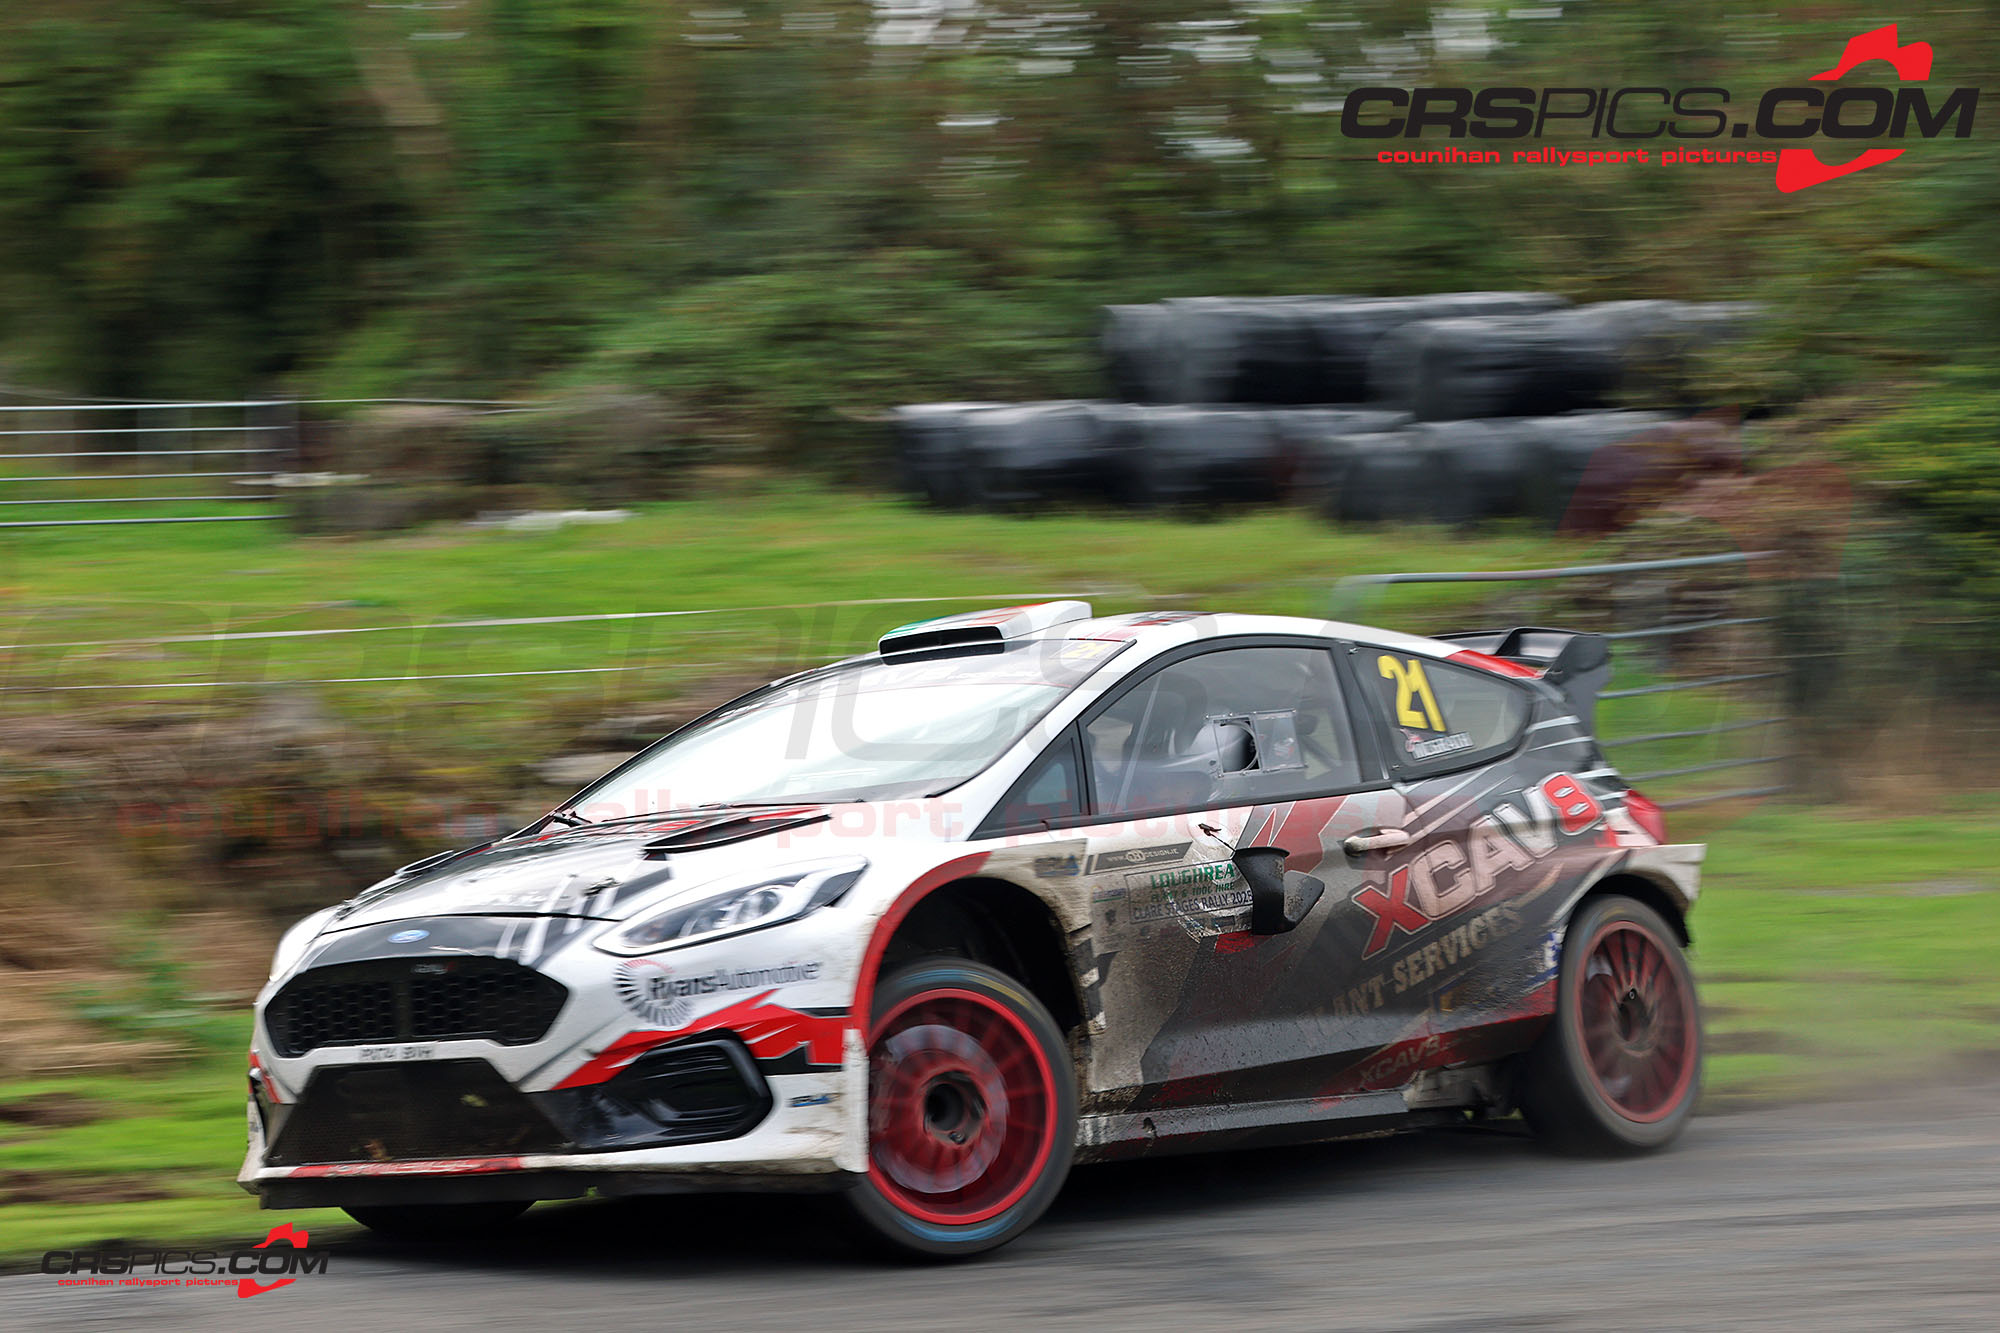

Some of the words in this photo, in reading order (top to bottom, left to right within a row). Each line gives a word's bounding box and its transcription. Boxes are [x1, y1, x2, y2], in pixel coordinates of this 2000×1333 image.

[1379, 654, 1448, 733] 21
[1151, 863, 1235, 890] LOUGHREA
[1351, 771, 1603, 960] XCAV8
[1133, 903, 1166, 920] CLARE
[1166, 897, 1200, 916] STAGES
[1202, 891, 1229, 909] RALLY
[1392, 901, 1523, 994] SERVICES
